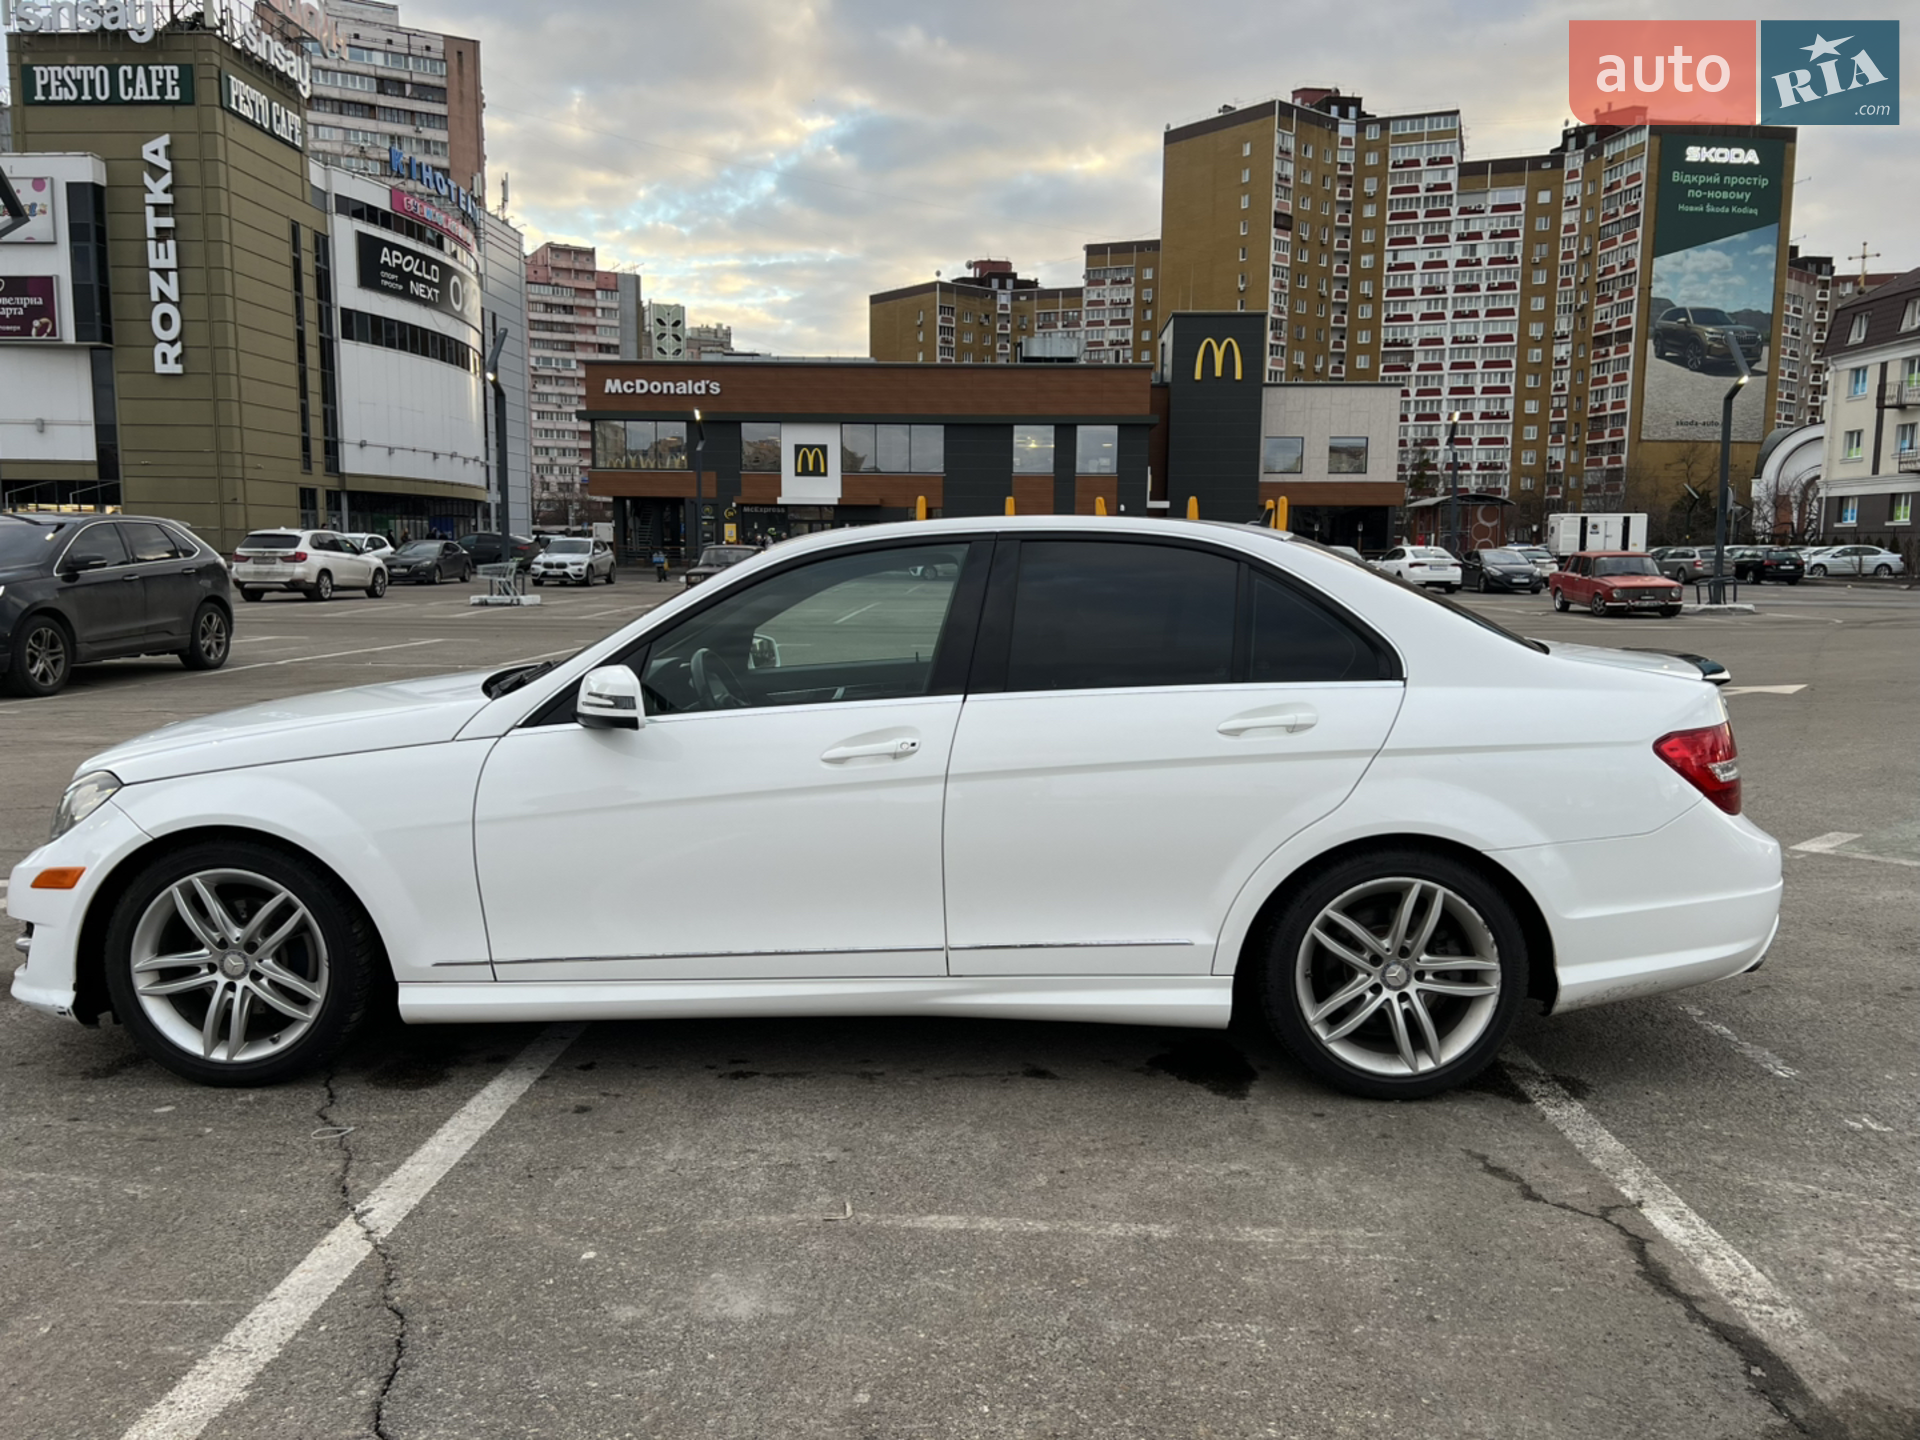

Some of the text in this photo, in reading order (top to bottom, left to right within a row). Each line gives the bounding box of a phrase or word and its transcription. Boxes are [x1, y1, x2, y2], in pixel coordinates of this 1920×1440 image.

[243, 18, 310, 99] sinsay
[33, 65, 180, 100] PESTO CAFE
[227, 75, 302, 147] PESTO CAFE
[1671, 171, 1769, 188] Відкрий простір
[1687, 188, 1751, 202] по-новому
[142, 133, 183, 374] ROZETKA
[380, 246, 439, 283] APOLLO
[410, 280, 440, 302] NEXT
[0, 307, 24, 318] арта
[604, 379, 721, 395] McDonald's
[743, 506, 786, 514] McExpress
